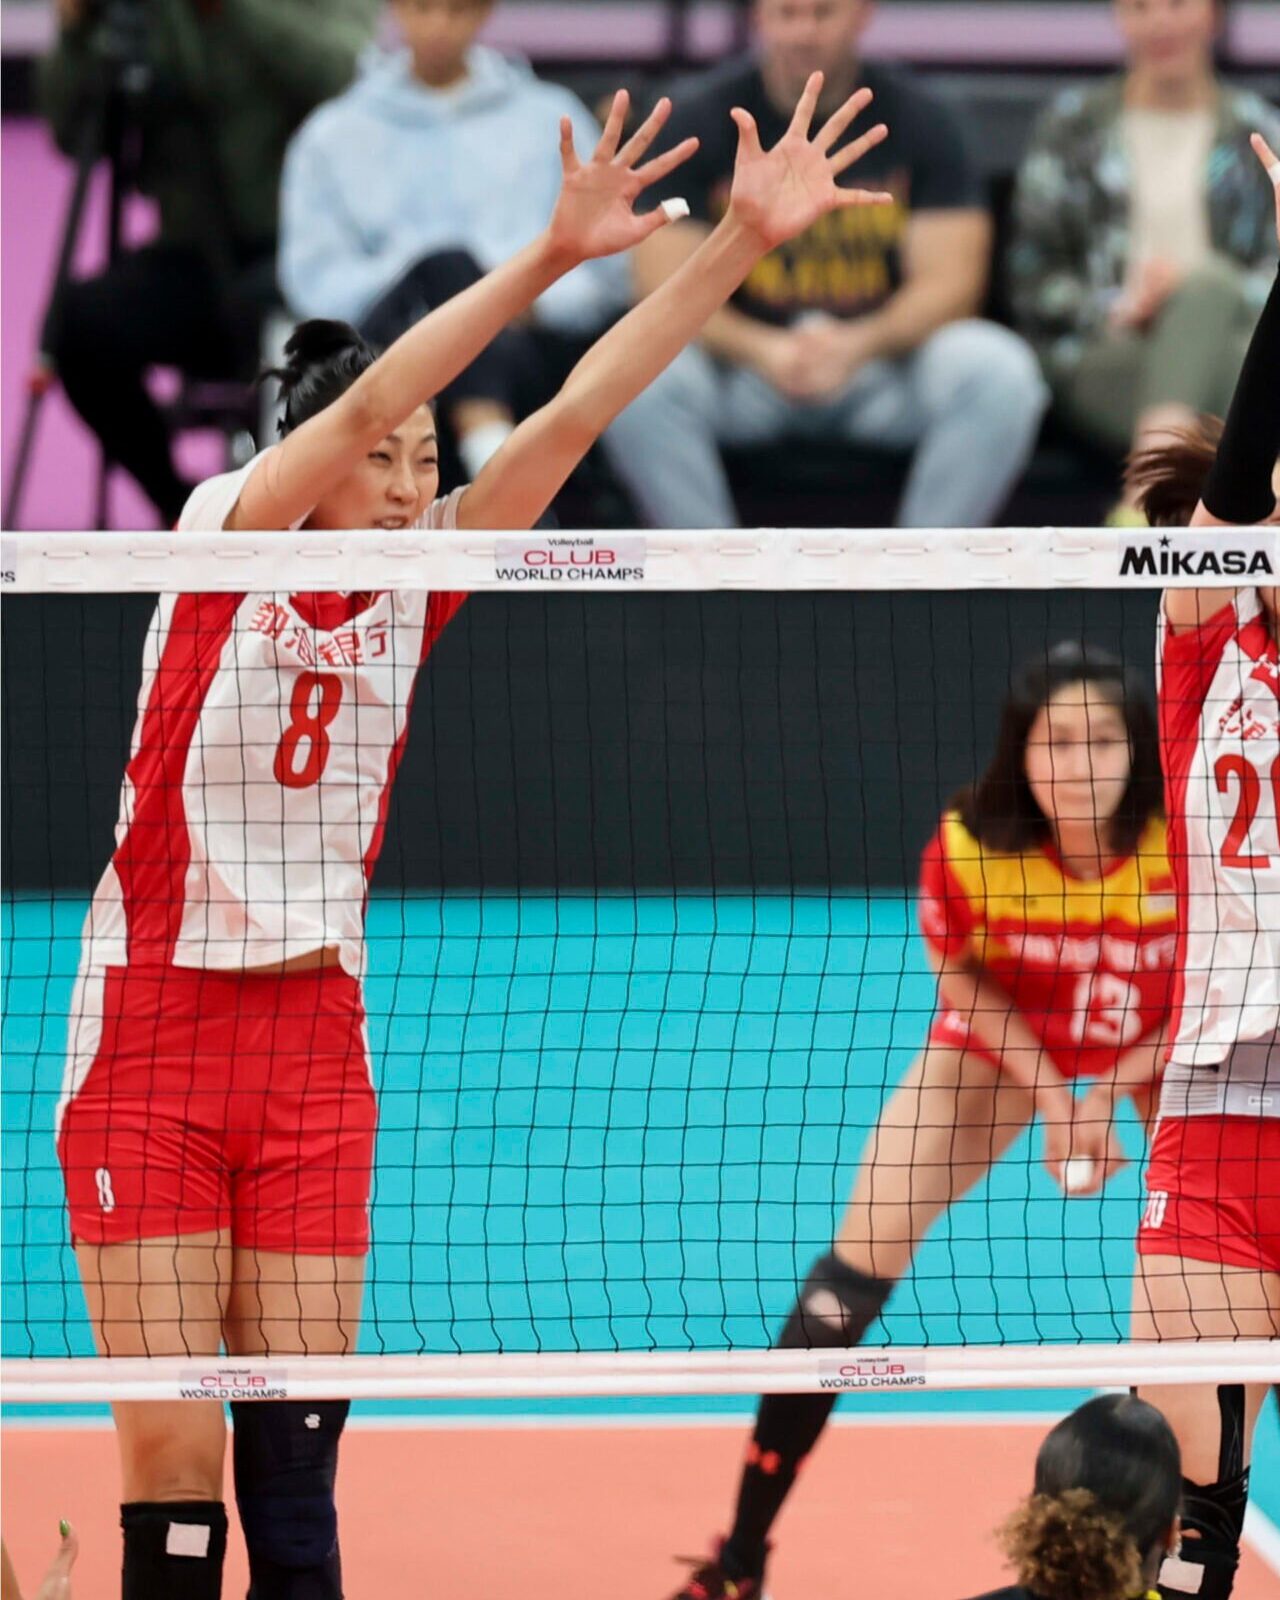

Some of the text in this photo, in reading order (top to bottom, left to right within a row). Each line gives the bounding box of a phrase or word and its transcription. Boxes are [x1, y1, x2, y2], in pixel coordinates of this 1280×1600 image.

[548, 538, 594, 547] Volleyball
[523, 550, 616, 566] CLUB
[1119, 541, 1274, 576] MIKASA
[495, 567, 644, 581] WORLD CHAMPS
[273, 671, 344, 789] 8
[1070, 971, 1142, 1047] 13
[95, 1167, 115, 1213] 8
[839, 1364, 905, 1376] CLUB
[200, 1376, 266, 1388] CLUB
[819, 1376, 926, 1388] WORLD CHAMPS
[180, 1388, 288, 1399] WORLD CHAMPS
